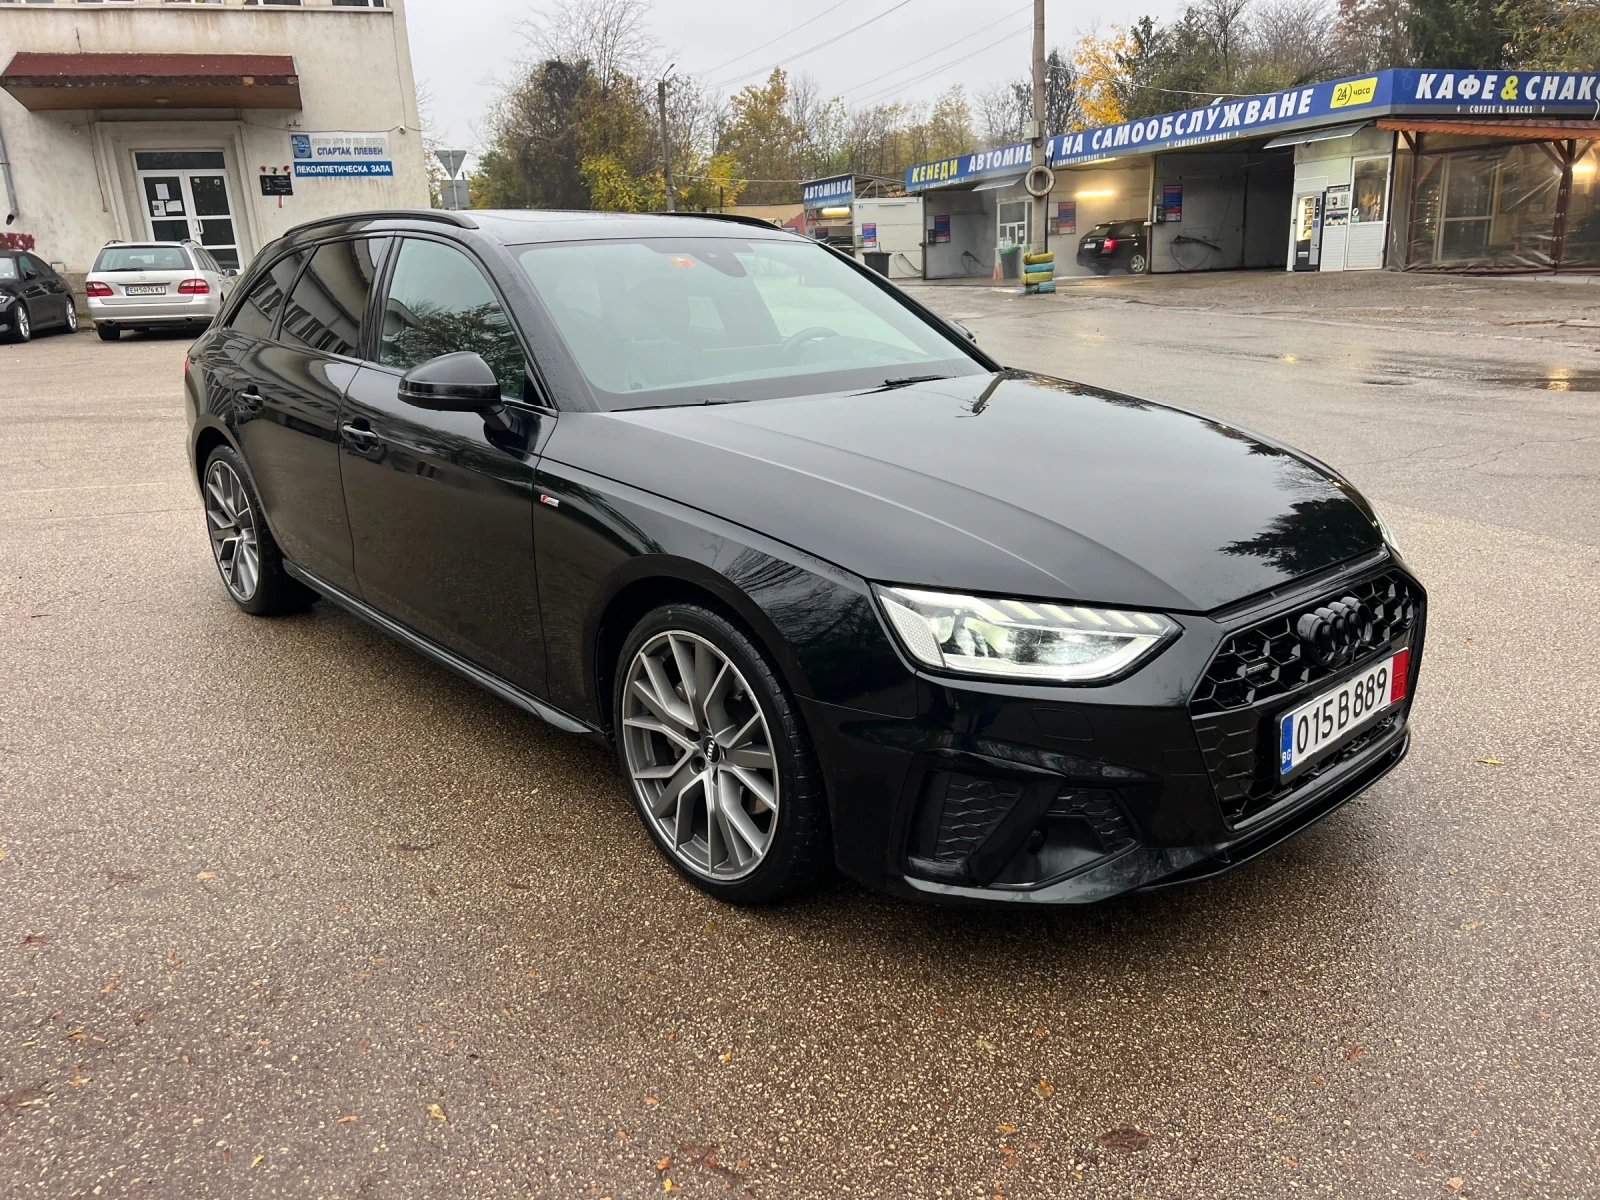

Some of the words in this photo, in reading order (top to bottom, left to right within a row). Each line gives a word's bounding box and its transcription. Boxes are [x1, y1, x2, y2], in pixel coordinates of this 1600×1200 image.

[1336, 86, 1348, 101] 24
[1415, 73, 1498, 100] КАФЕ
[1500, 75, 1518, 100] &
[1525, 75, 1600, 101] СНАК
[1469, 105, 1496, 113] COFFEE
[1498, 105, 1503, 113] &
[1506, 105, 1533, 113] SNACKS
[912, 159, 958, 183] КЕНЕДИ
[968, 139, 1055, 173] АВТОМИВА
[1061, 133, 1083, 156] НА
[1092, 88, 1315, 150] САМООБСЛУЖВАНЕ
[317, 147, 351, 156] СПАРТАК
[354, 147, 383, 156] ПЛЕВЕН
[296, 165, 368, 174] ЛЕКОАТЛЕТИЧЕСКА
[370, 165, 391, 173] ЗАЛА
[804, 179, 852, 200] АВТОМИВКА
[1282, 749, 1292, 764] BG
